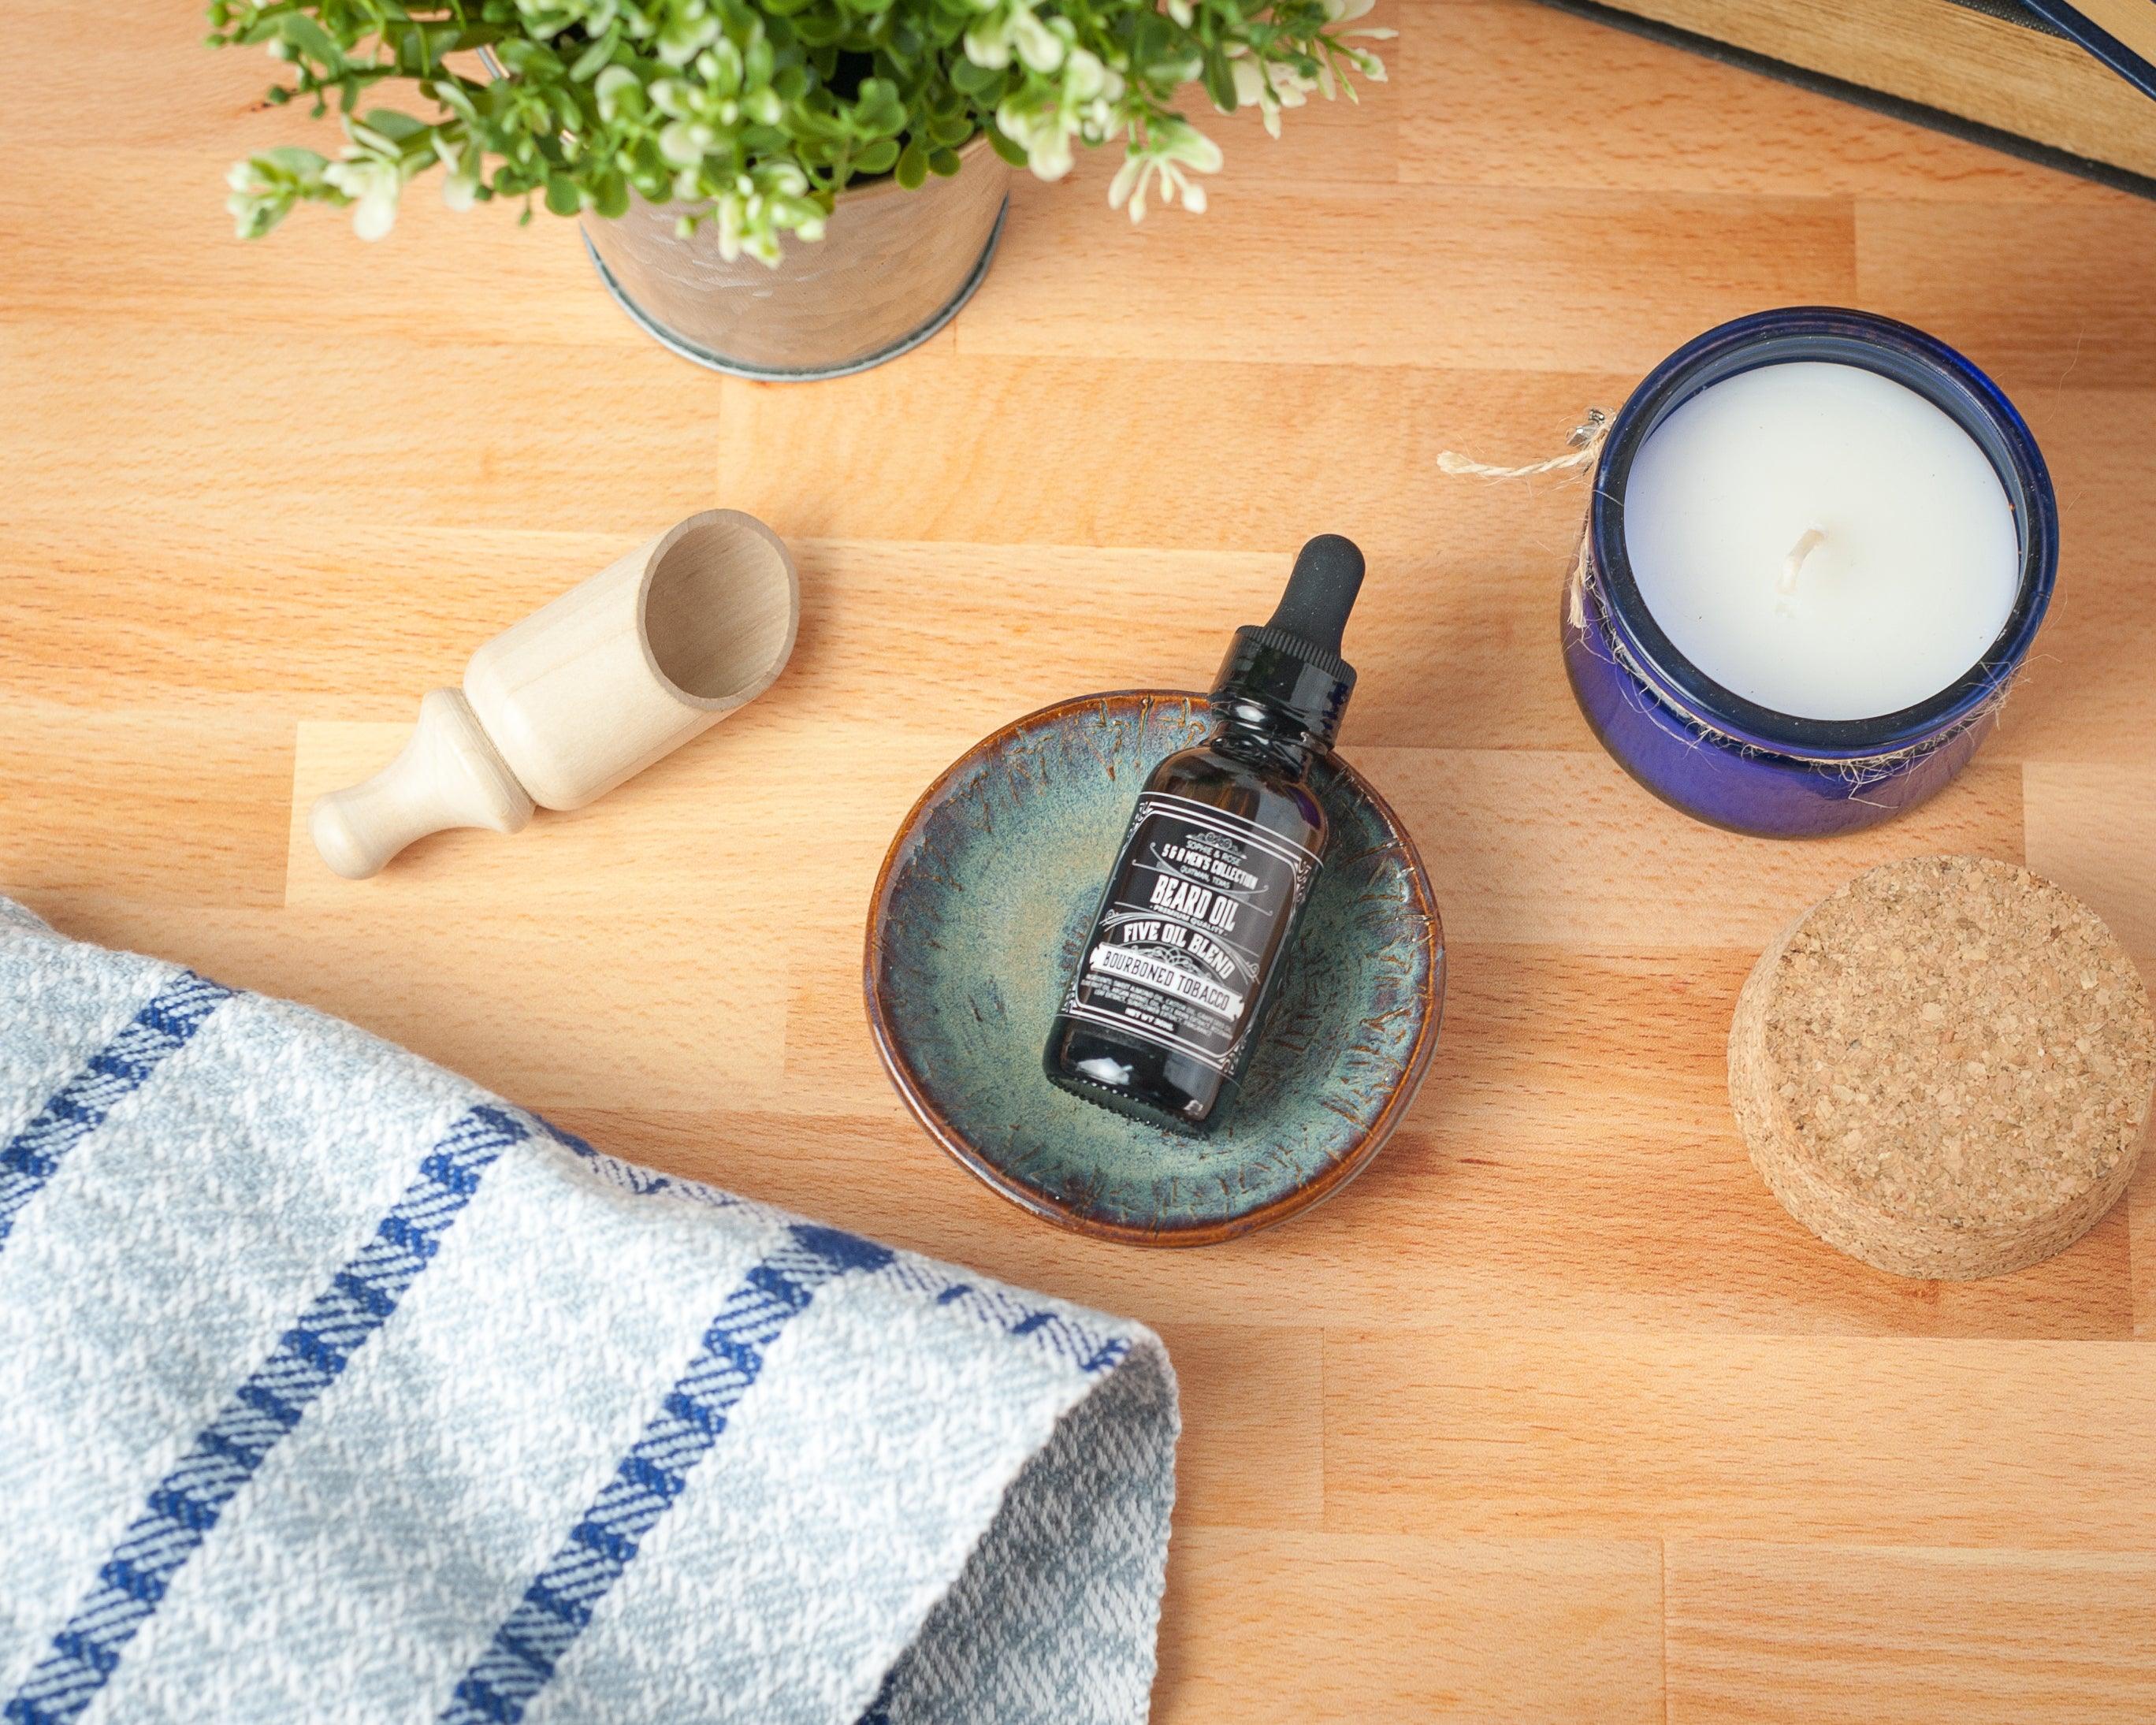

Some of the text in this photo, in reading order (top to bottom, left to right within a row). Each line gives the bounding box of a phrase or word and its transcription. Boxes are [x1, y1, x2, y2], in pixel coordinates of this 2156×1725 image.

[1150, 875, 1239, 931] BEARD OIL
[1124, 922, 1235, 979] FIVE OIL BLEND
[1103, 951, 1174, 986] BOURBONED
[1177, 975, 1229, 1010] TOBACCO
